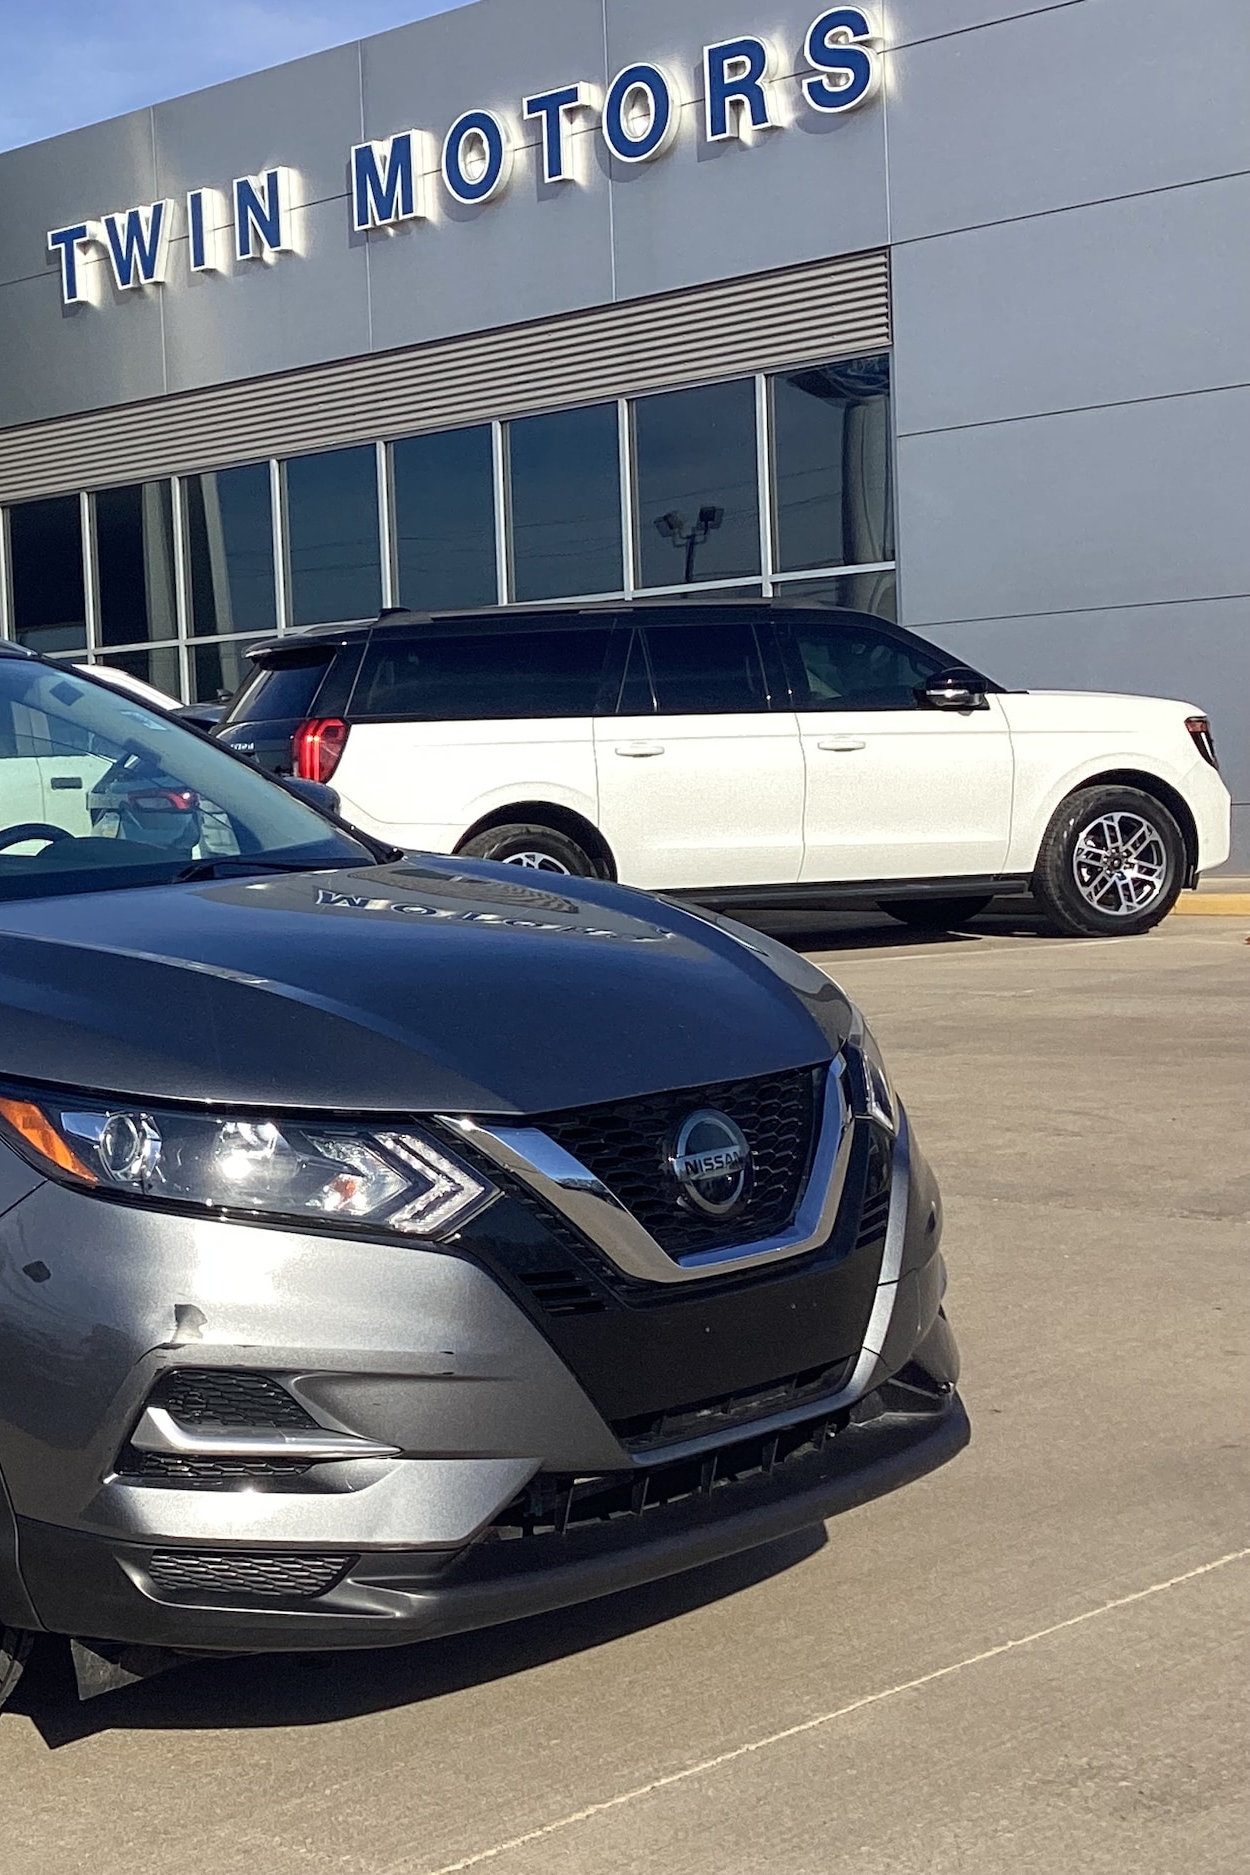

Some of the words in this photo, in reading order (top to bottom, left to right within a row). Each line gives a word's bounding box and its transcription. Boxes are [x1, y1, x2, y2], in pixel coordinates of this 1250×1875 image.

[48, 166, 294, 305] TWIN
[352, 5, 884, 233] MOTORS
[685, 1151, 742, 1176] NISSAN
